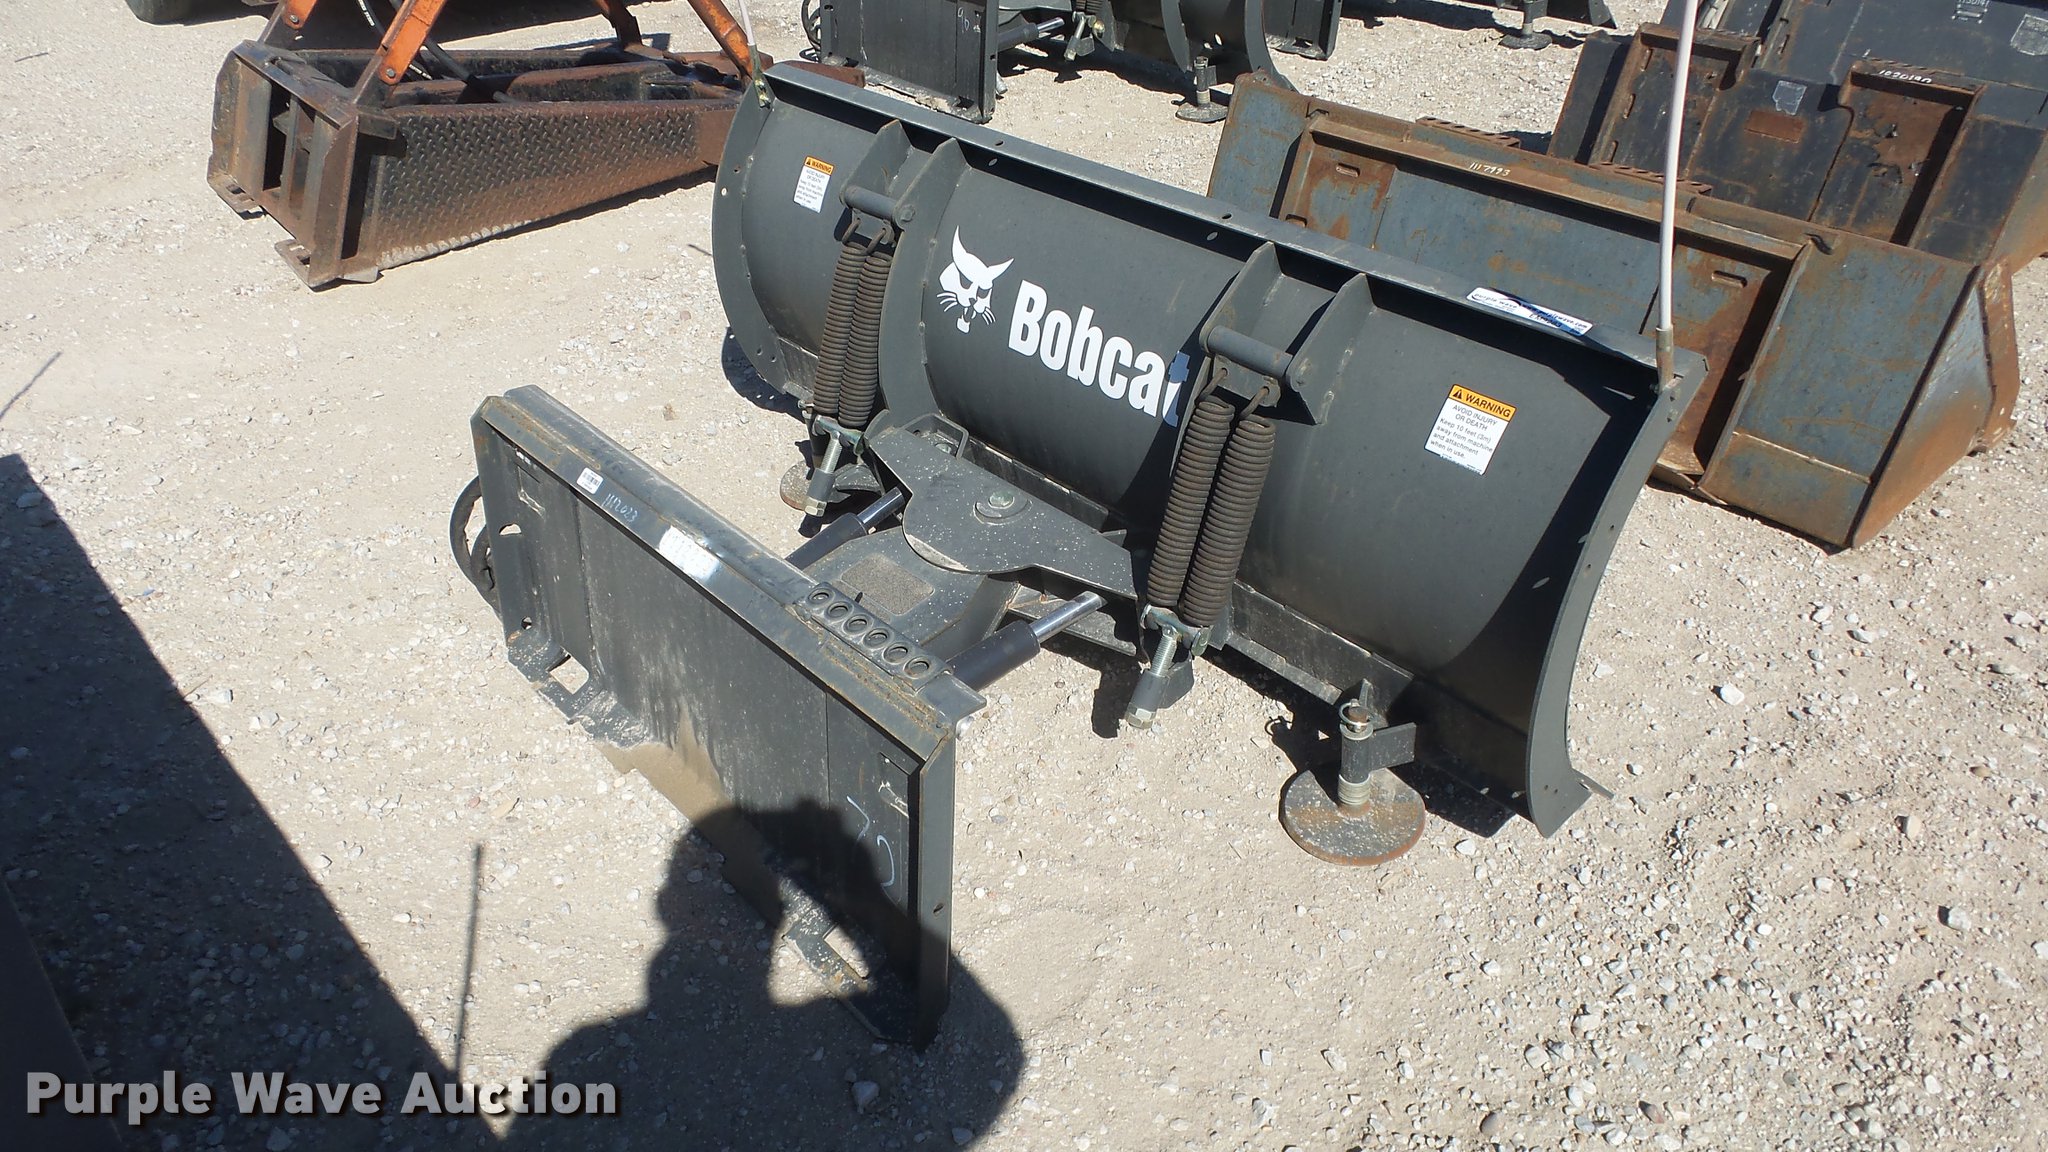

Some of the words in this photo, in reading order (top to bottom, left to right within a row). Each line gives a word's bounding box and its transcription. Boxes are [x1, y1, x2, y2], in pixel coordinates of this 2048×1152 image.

[1008, 279, 1191, 428] Bobcat
[1452, 404, 1473, 416] AVOID
[1473, 412, 1498, 426] INJURY
[1465, 393, 1511, 418] WARNING
[1440, 418, 1455, 429] Keep
[1465, 428, 1477, 437] feet
[1455, 413, 1466, 422] OR
[1466, 418, 1488, 431] DEATH
[1430, 441, 1446, 450] when
[1453, 449, 1466, 459] use.
[1433, 433, 1445, 441] and
[1445, 437, 1479, 455] attachment
[1437, 427, 1451, 436] away
[1453, 431, 1467, 441] from
[1468, 439, 1493, 452] machine
